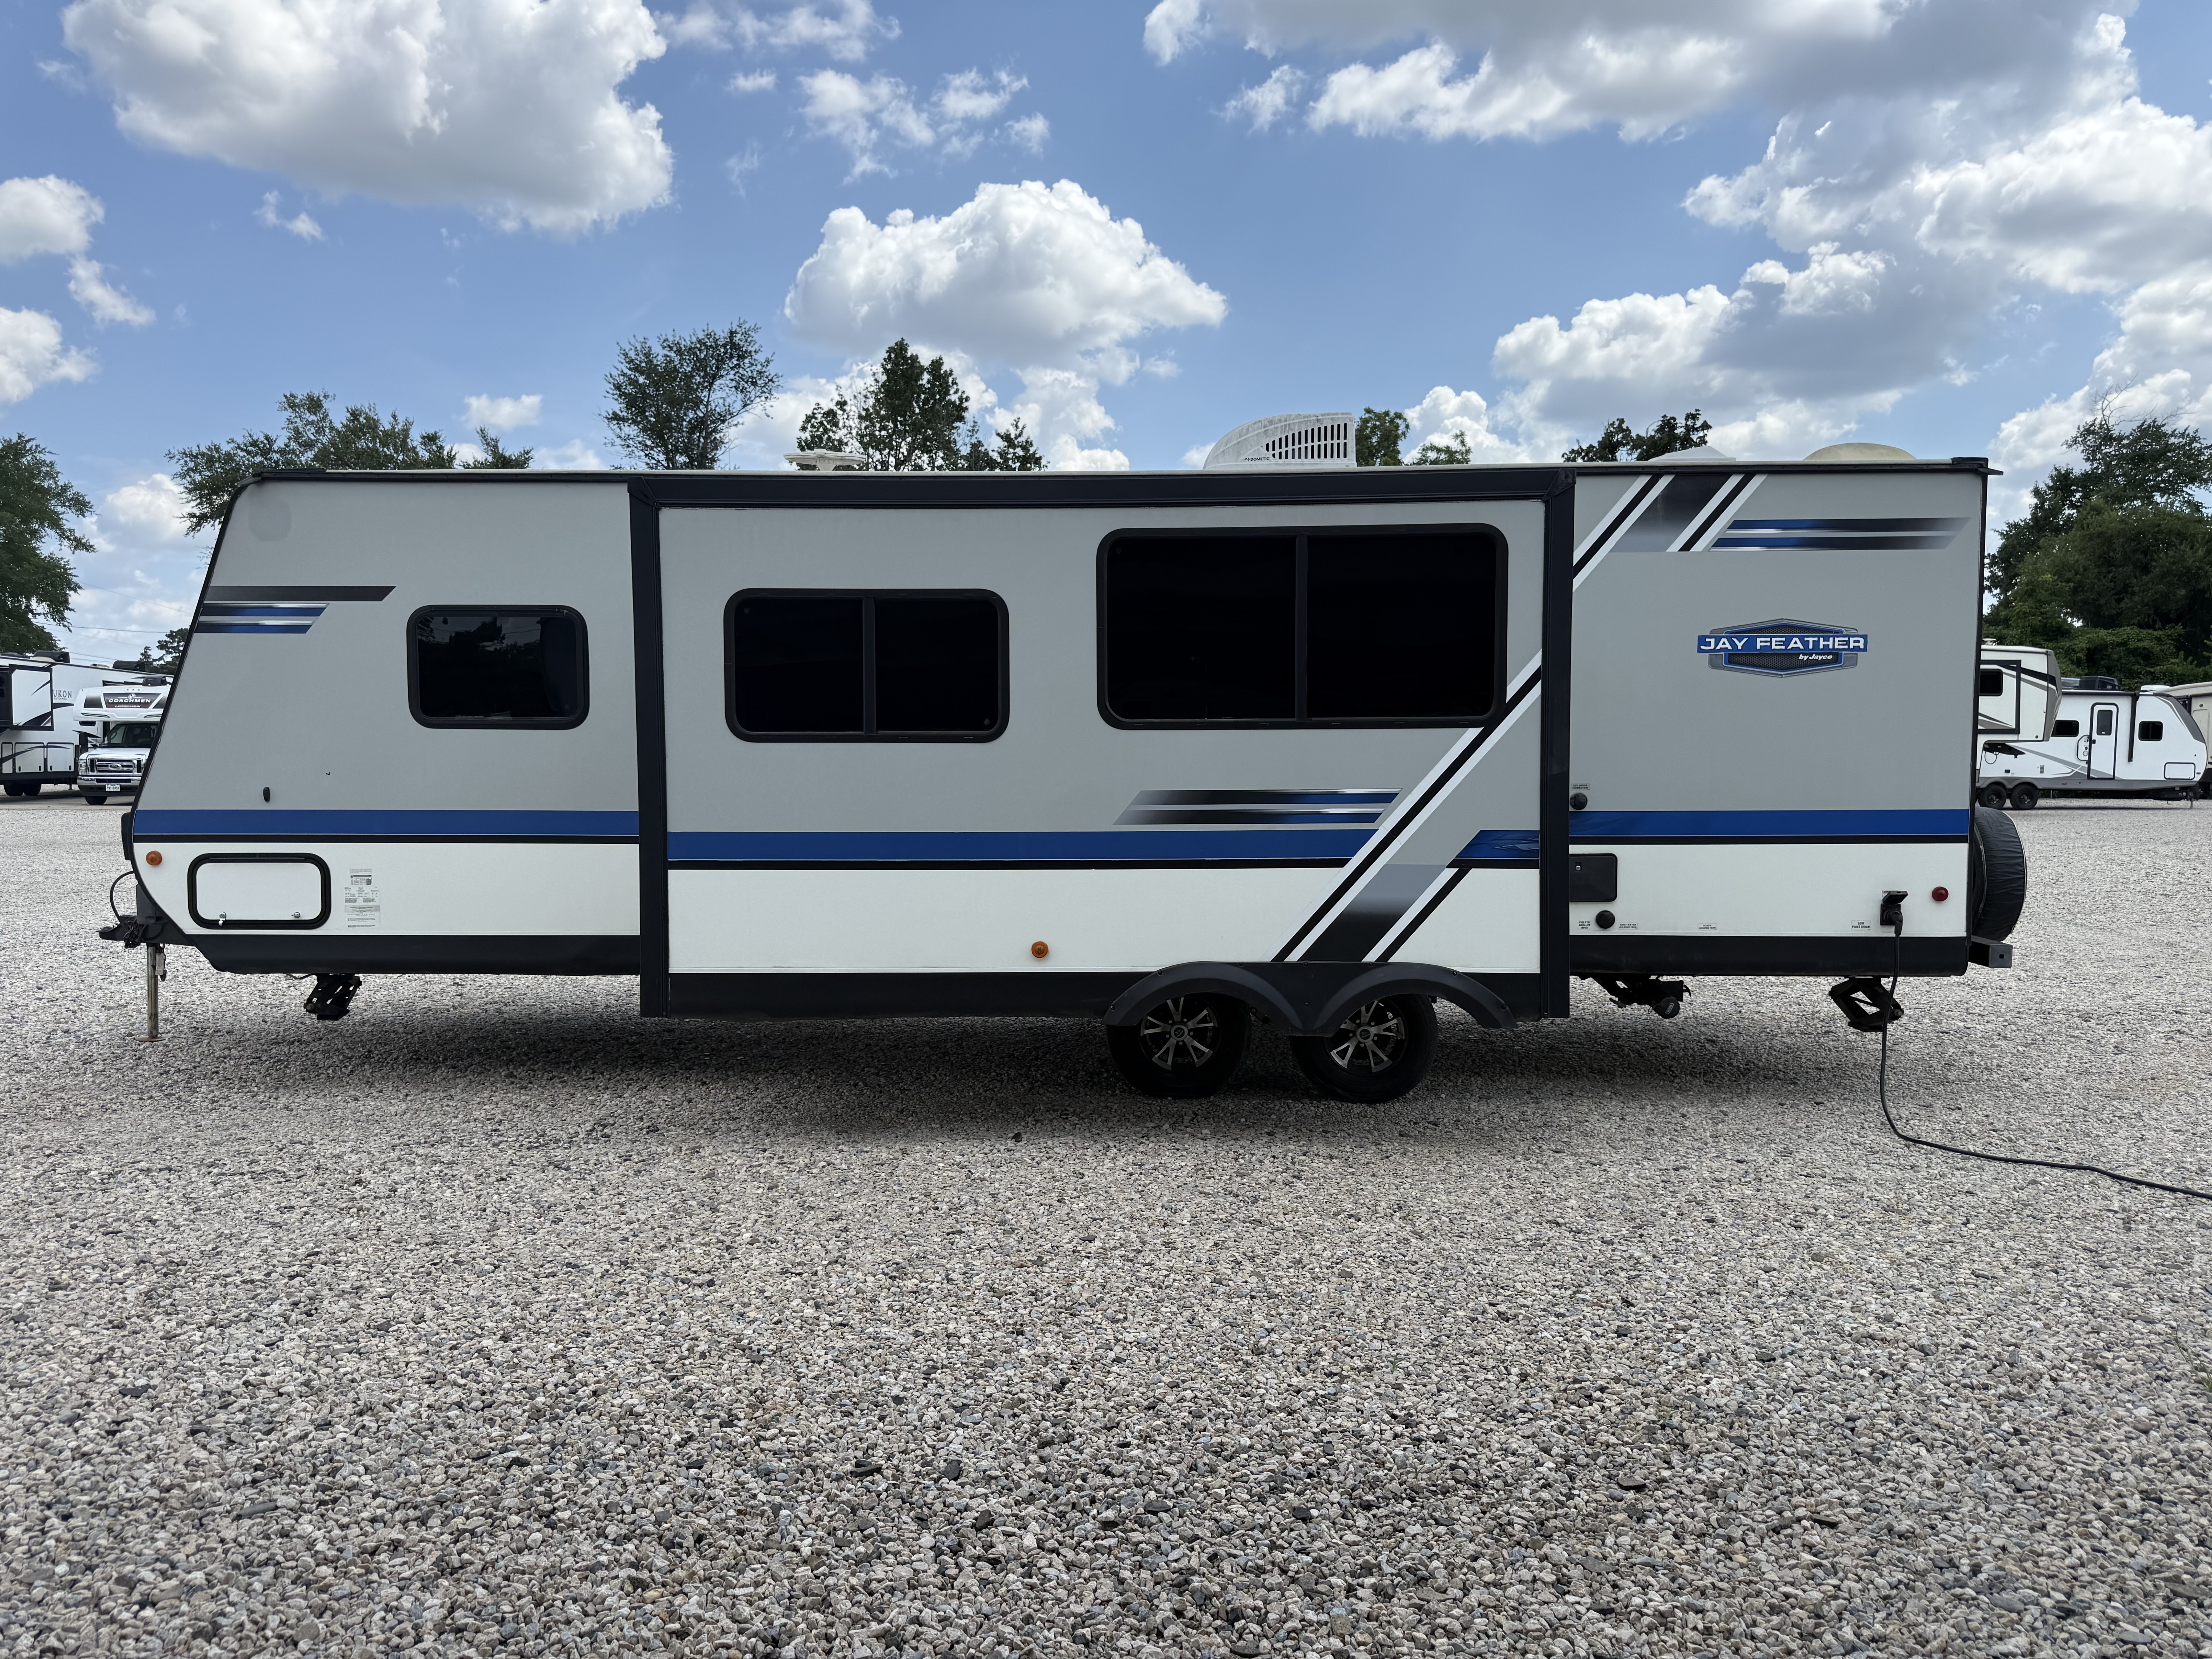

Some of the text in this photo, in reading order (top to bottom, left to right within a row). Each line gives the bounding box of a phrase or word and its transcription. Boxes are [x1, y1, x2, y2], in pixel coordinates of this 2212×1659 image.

[1700, 637, 1864, 650] JAY FEATHER
[53, 690, 72, 698] UKON
